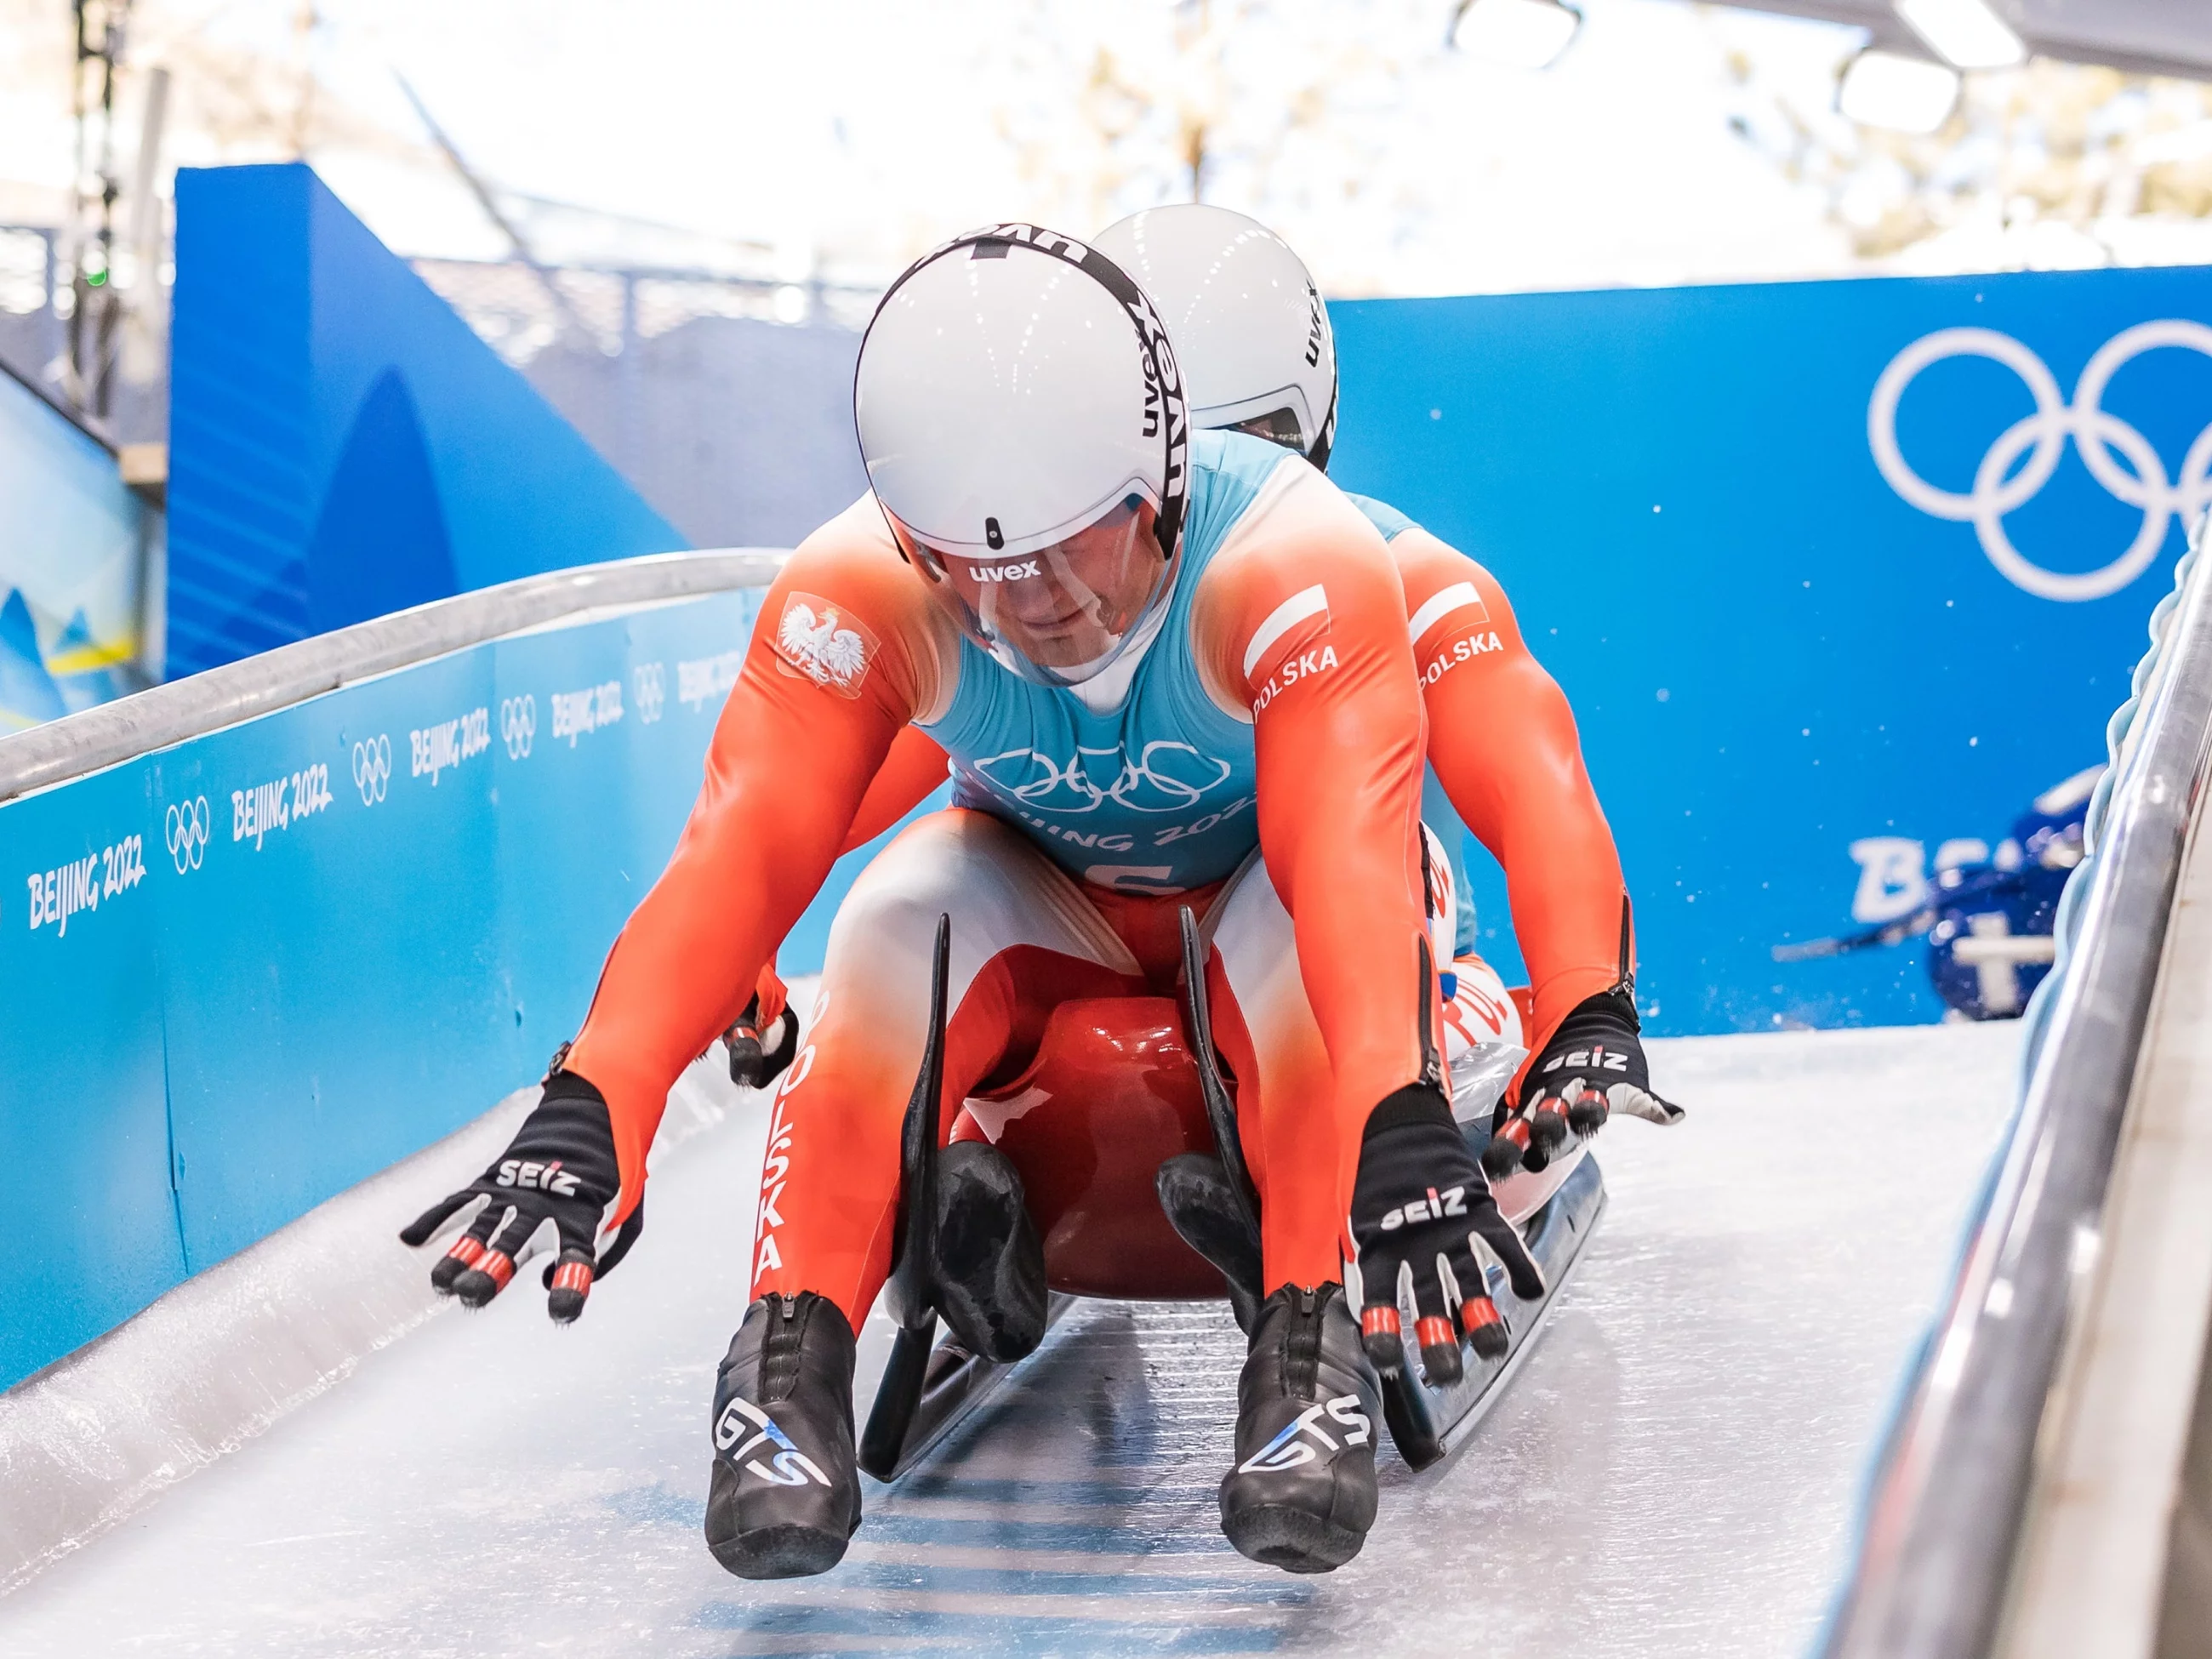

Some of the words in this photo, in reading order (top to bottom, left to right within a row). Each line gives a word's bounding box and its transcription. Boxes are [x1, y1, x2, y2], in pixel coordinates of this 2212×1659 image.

[1126, 290, 1186, 498] uvex
[969, 560, 1041, 582] uvex
[1253, 645, 1339, 725] POLSKA
[410, 718, 459, 786] BEIJING
[460, 707, 491, 758] 2022
[231, 777, 288, 852] BEIJING
[292, 763, 334, 822] 2022
[1153, 791, 1257, 847] 202
[27, 852, 100, 938] BEIJING
[103, 834, 147, 902] 2022
[754, 989, 830, 1288] POLSKA
[715, 1397, 832, 1487] GTS
[1239, 1394, 1371, 1474] GTS
